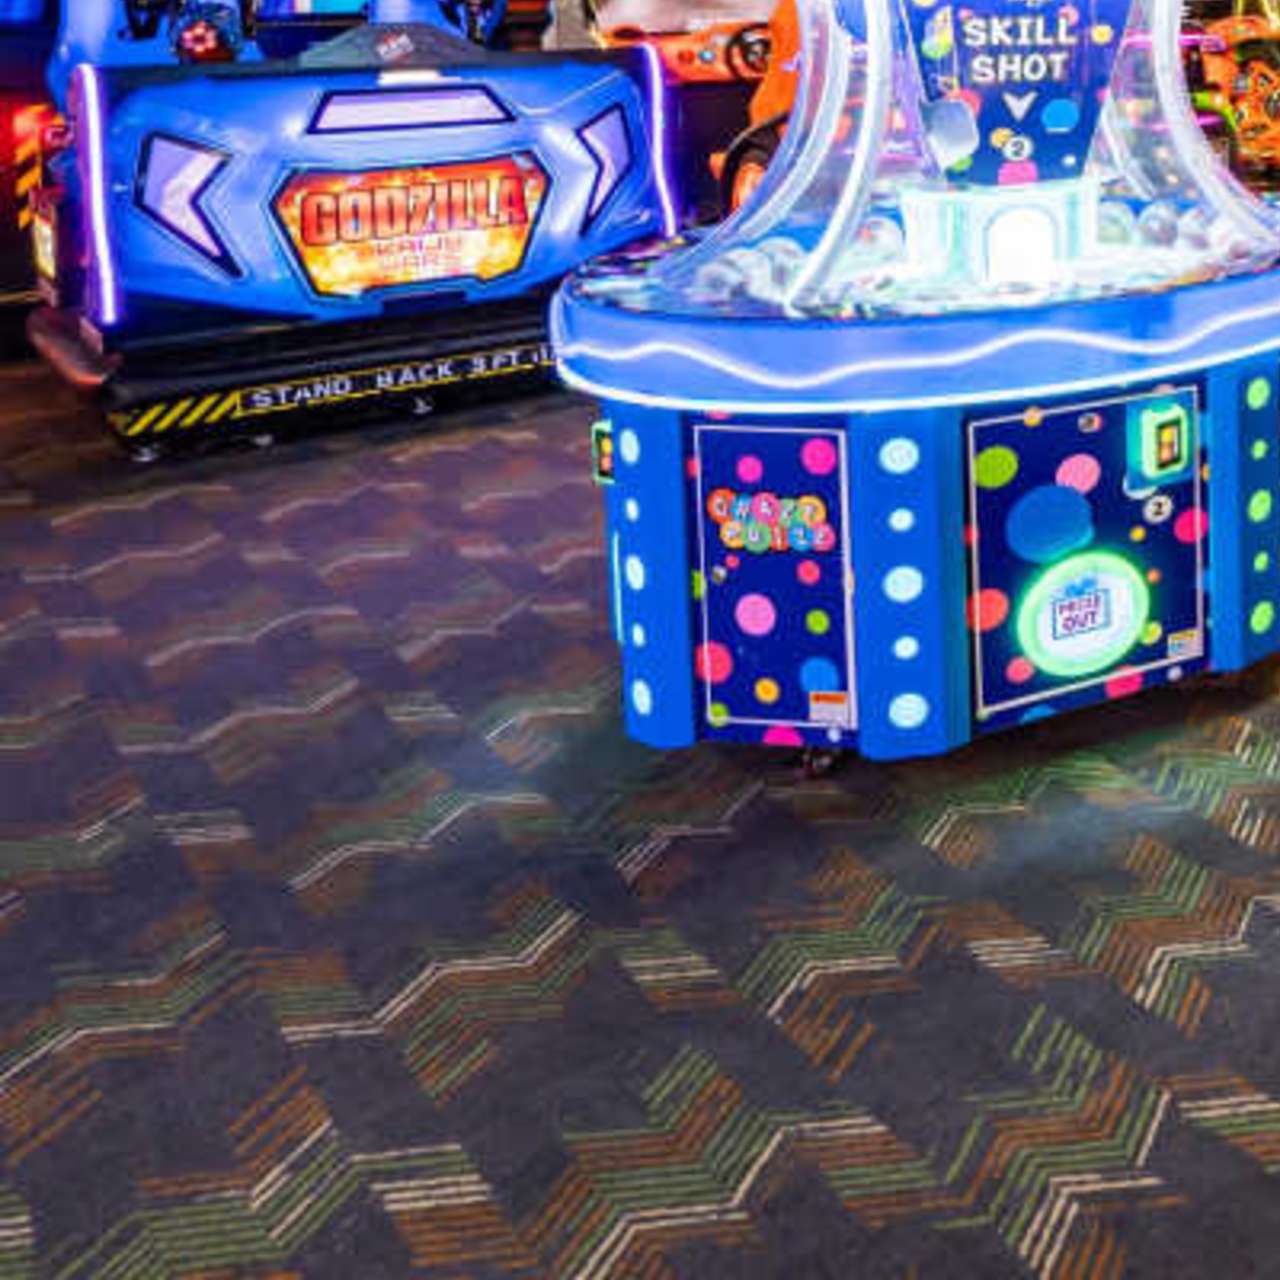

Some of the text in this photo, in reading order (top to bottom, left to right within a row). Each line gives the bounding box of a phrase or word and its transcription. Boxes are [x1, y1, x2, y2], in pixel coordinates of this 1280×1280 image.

[963, 16, 1078, 47] SKILL
[970, 52, 1069, 82] SHOT
[301, 175, 529, 247] GODZILLA
[252, 379, 351, 410] STAND
[375, 361, 453, 389] BACK
[1061, 610, 1099, 633] OUT
